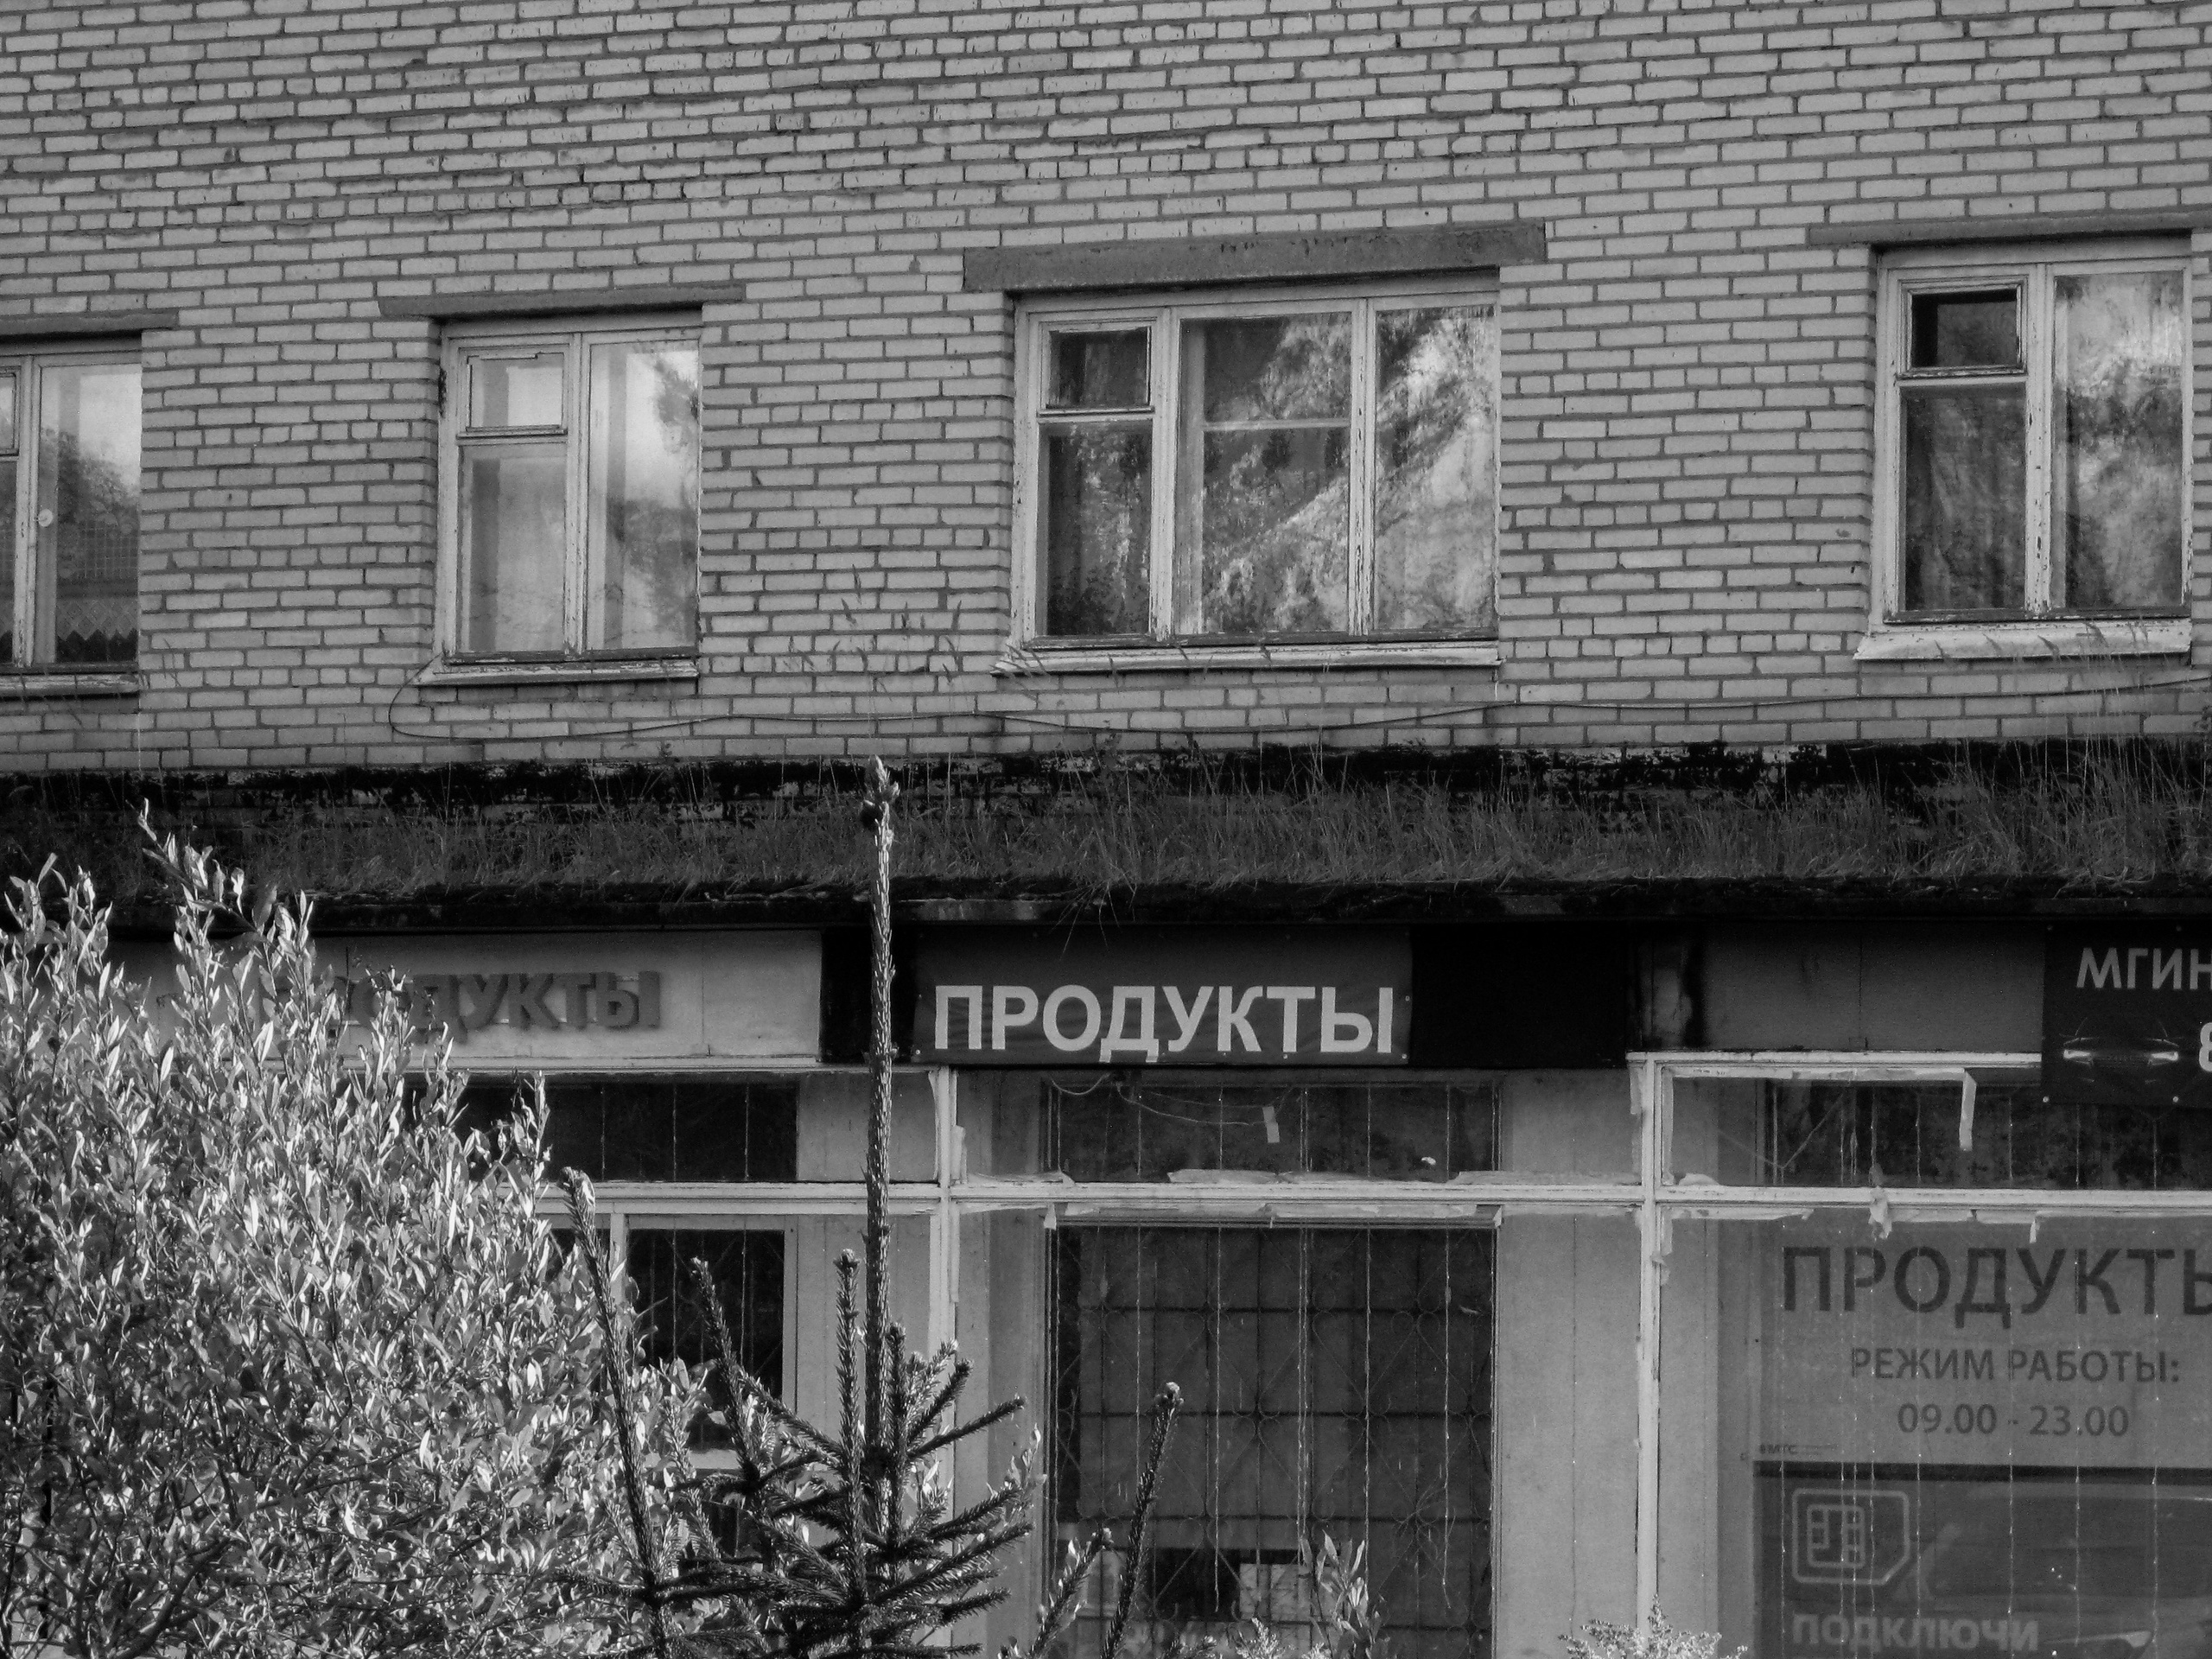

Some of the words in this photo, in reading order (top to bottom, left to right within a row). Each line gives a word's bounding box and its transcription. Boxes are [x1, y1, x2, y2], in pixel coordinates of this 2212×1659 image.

[934, 984, 1394, 1063] ПРОДУКТЫ
[1851, 1347, 1994, 1380] РЕЖИМ
[2007, 1349, 2179, 1382] РАБОТЫ:
[1897, 1402, 1997, 1434] 09.00
[2030, 1404, 2129, 1437] 23.00
[1791, 1612, 2039, 1653] ПОДКЛЮЧИ
